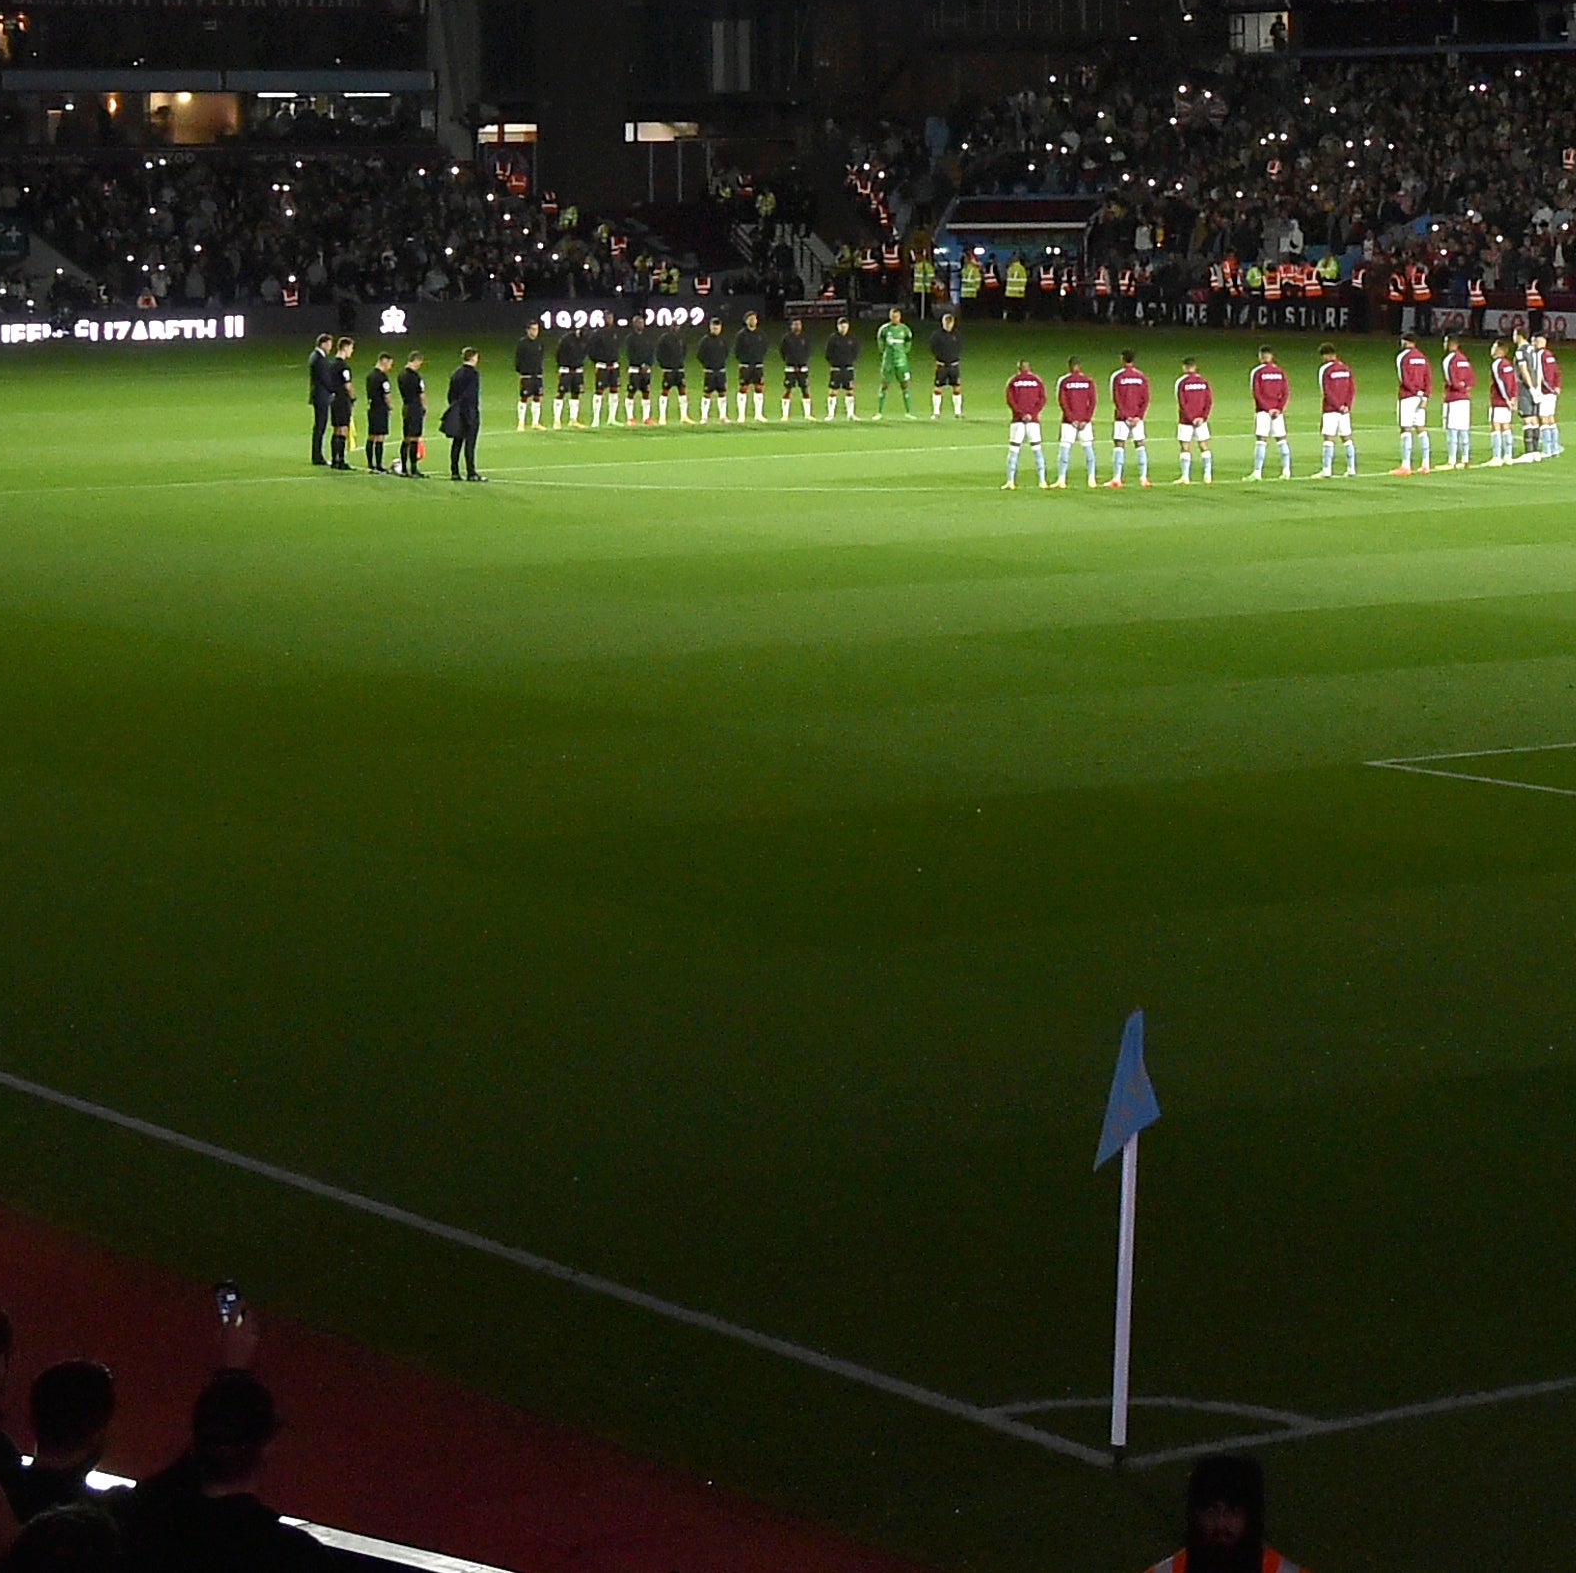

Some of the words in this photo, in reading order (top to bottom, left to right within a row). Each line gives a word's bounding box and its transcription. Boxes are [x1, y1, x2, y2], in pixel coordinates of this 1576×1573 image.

[224, 315, 244, 338] II
[539, 309, 605, 331] 1926
[1498, 312, 1567, 335] CAOO
